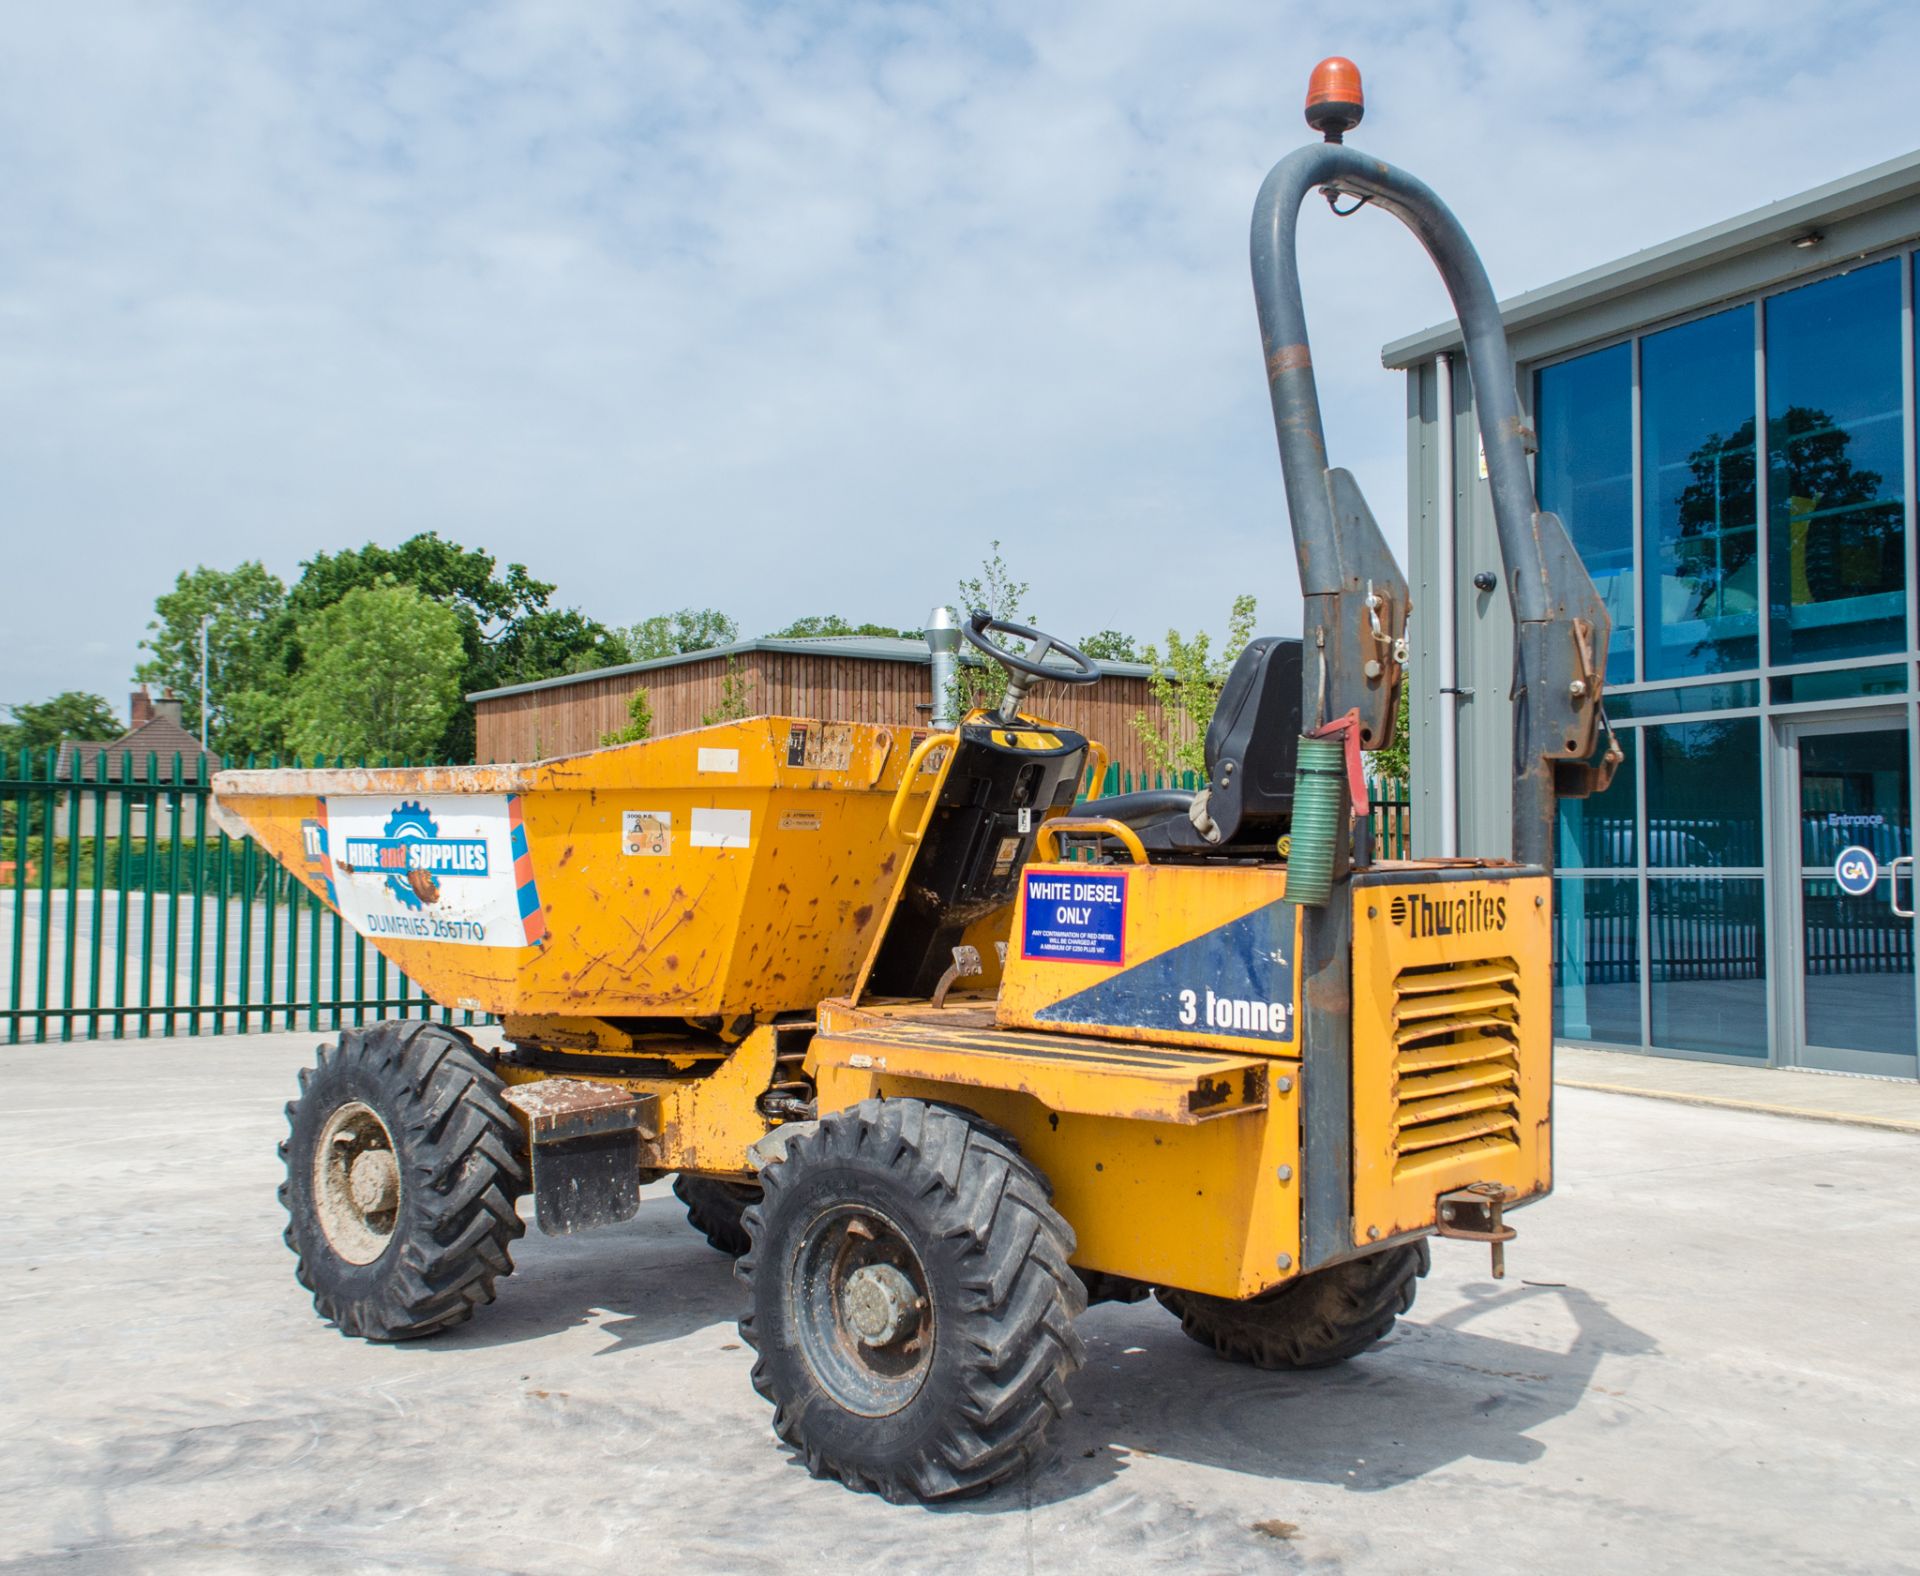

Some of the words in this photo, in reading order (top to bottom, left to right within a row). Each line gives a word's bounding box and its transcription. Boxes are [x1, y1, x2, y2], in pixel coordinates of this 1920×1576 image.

[1828, 813, 1883, 825] Entrance
[348, 843, 378, 867] HIRE
[380, 844, 407, 868] and
[409, 844, 486, 870] SUPPLIES
[1841, 861, 1869, 880] GA
[1029, 882, 1071, 900] WHITE
[1074, 884, 1121, 902] DIESEL
[1056, 906, 1091, 925] ONLY
[1408, 891, 1507, 938] Thwaites
[367, 914, 429, 936] DUMFRIES
[432, 919, 485, 941] 266770
[1179, 989, 1197, 1025] 3
[1206, 990, 1287, 1033] tonne
